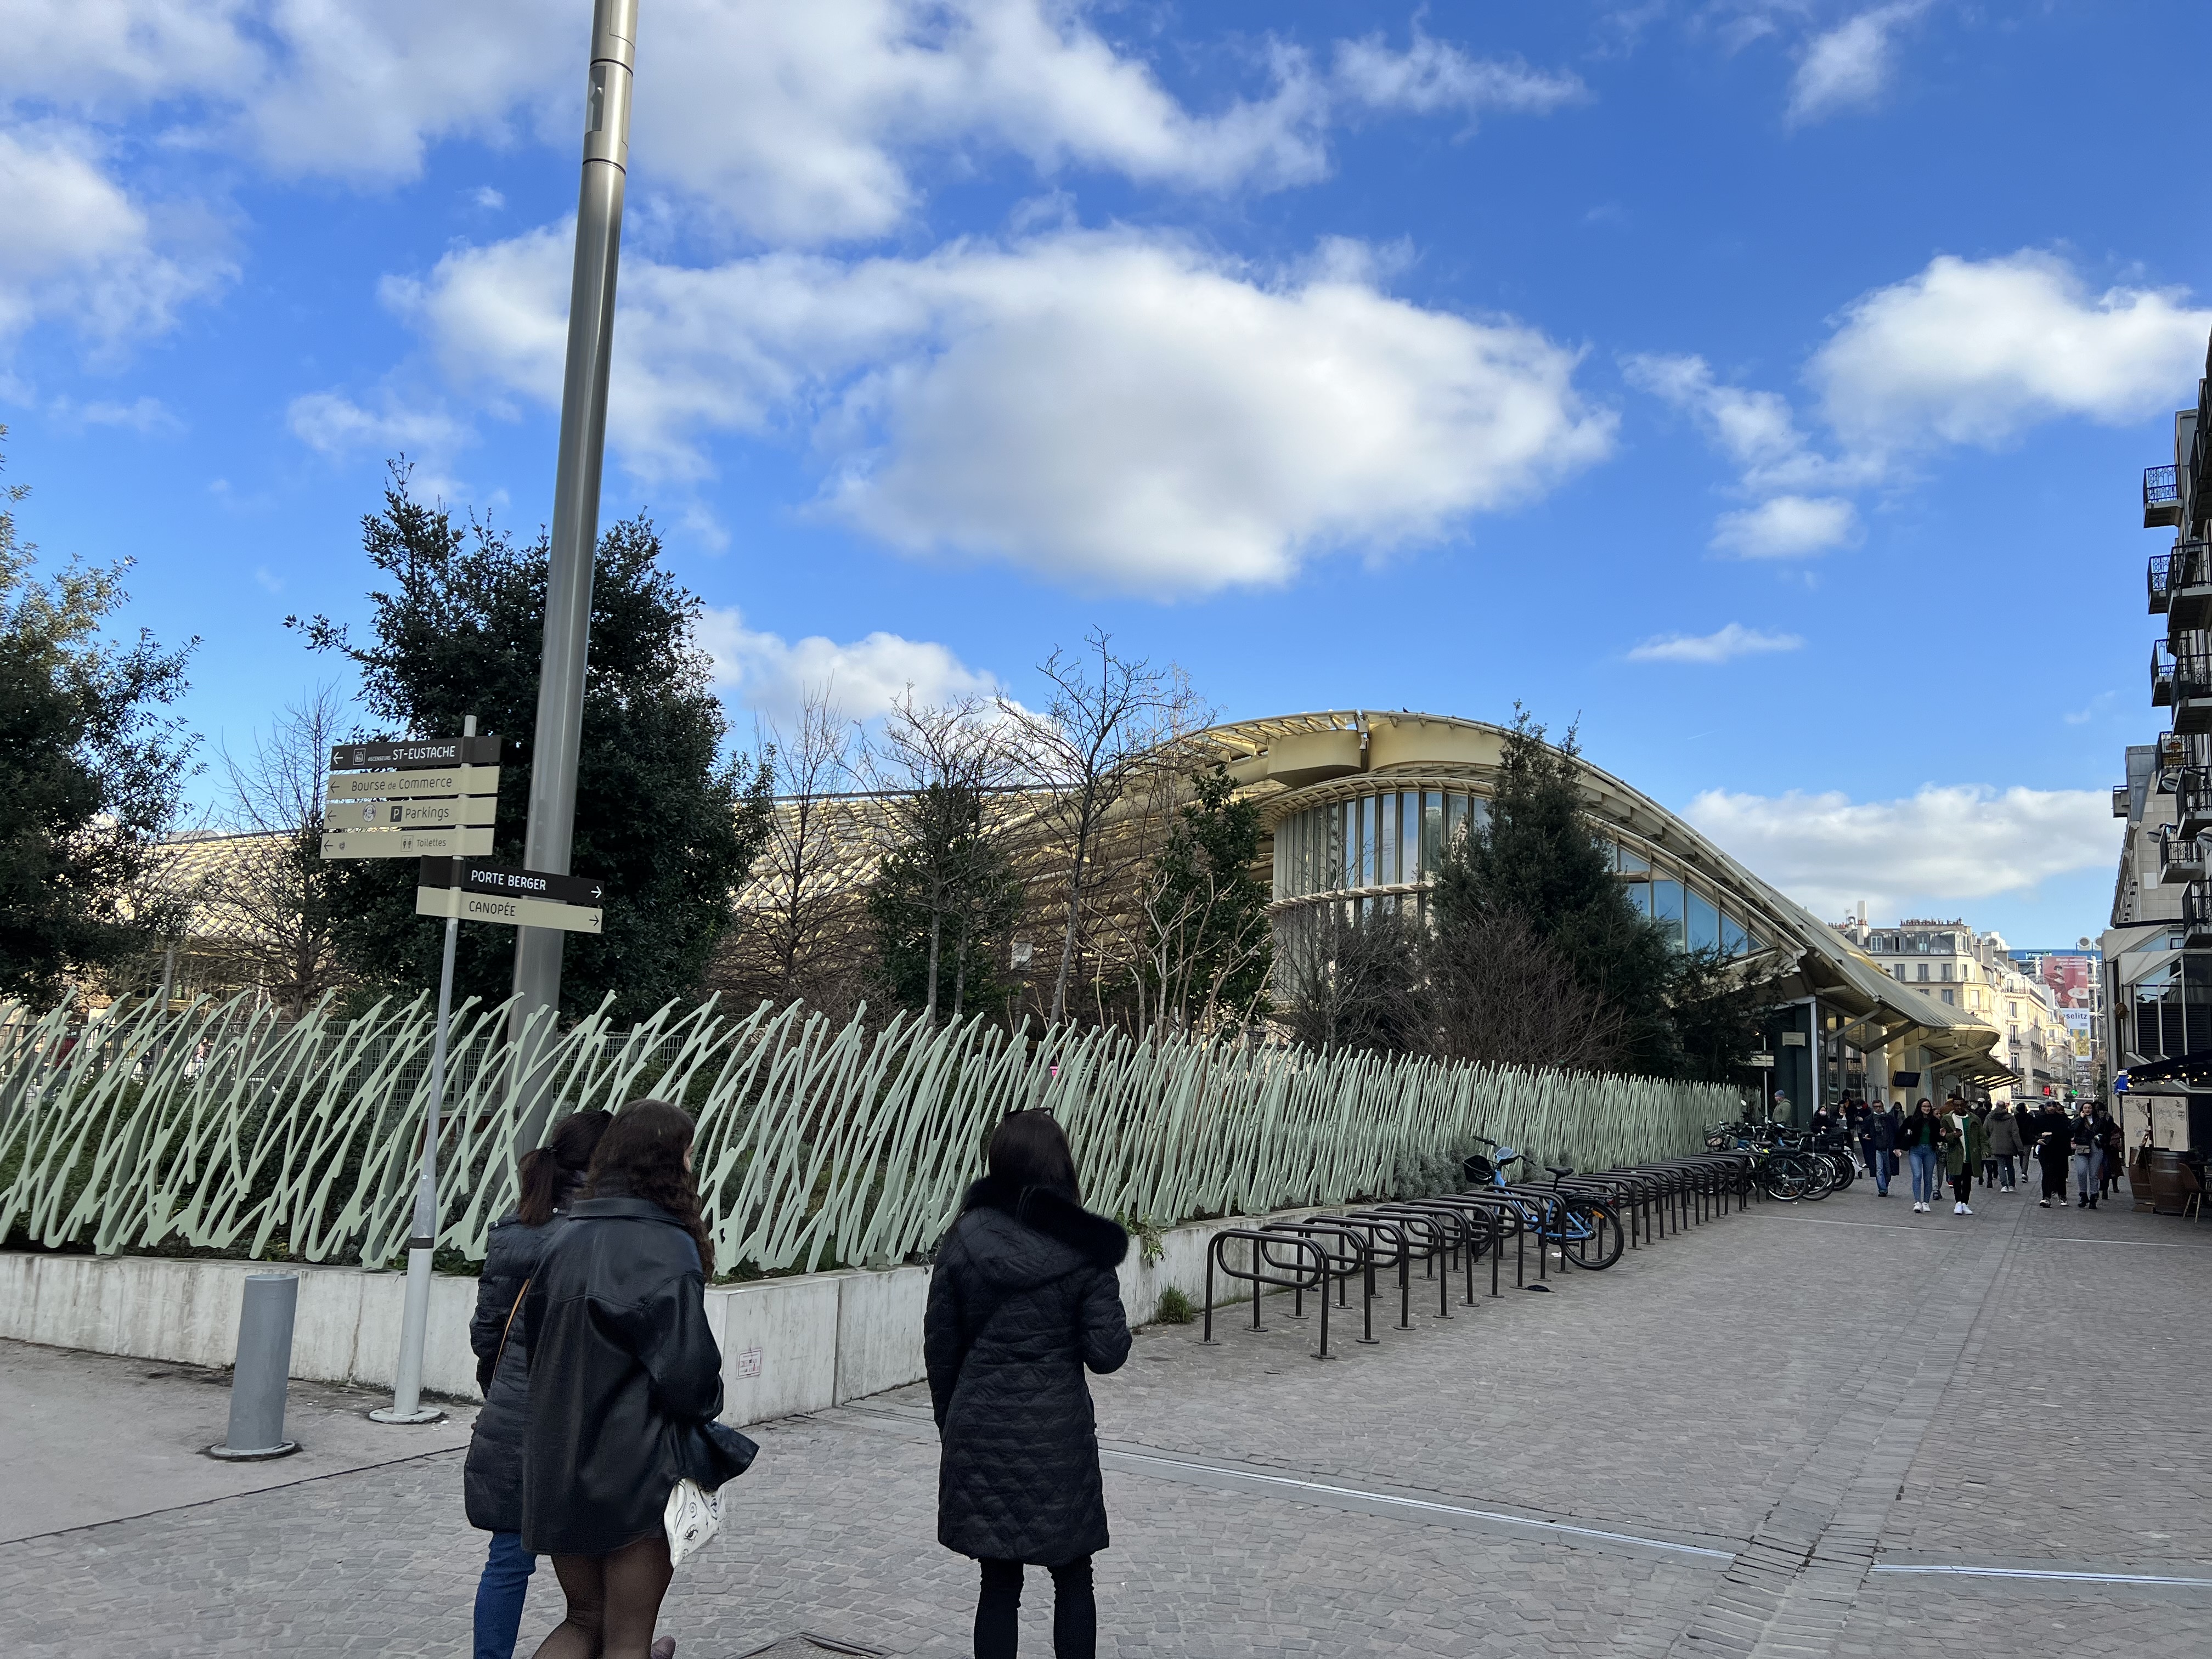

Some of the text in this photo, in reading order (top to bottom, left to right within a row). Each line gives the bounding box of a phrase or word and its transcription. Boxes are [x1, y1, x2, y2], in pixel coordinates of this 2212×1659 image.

[392, 746, 456, 760] ST-EUSTACHE
[352, 777, 452, 792] Bourse de Commerce
[405, 806, 449, 821] Parkings
[416, 838, 447, 847] Toilettes
[471, 870, 546, 890] PORTE BERGER
[469, 900, 516, 917] CANOPÉE
